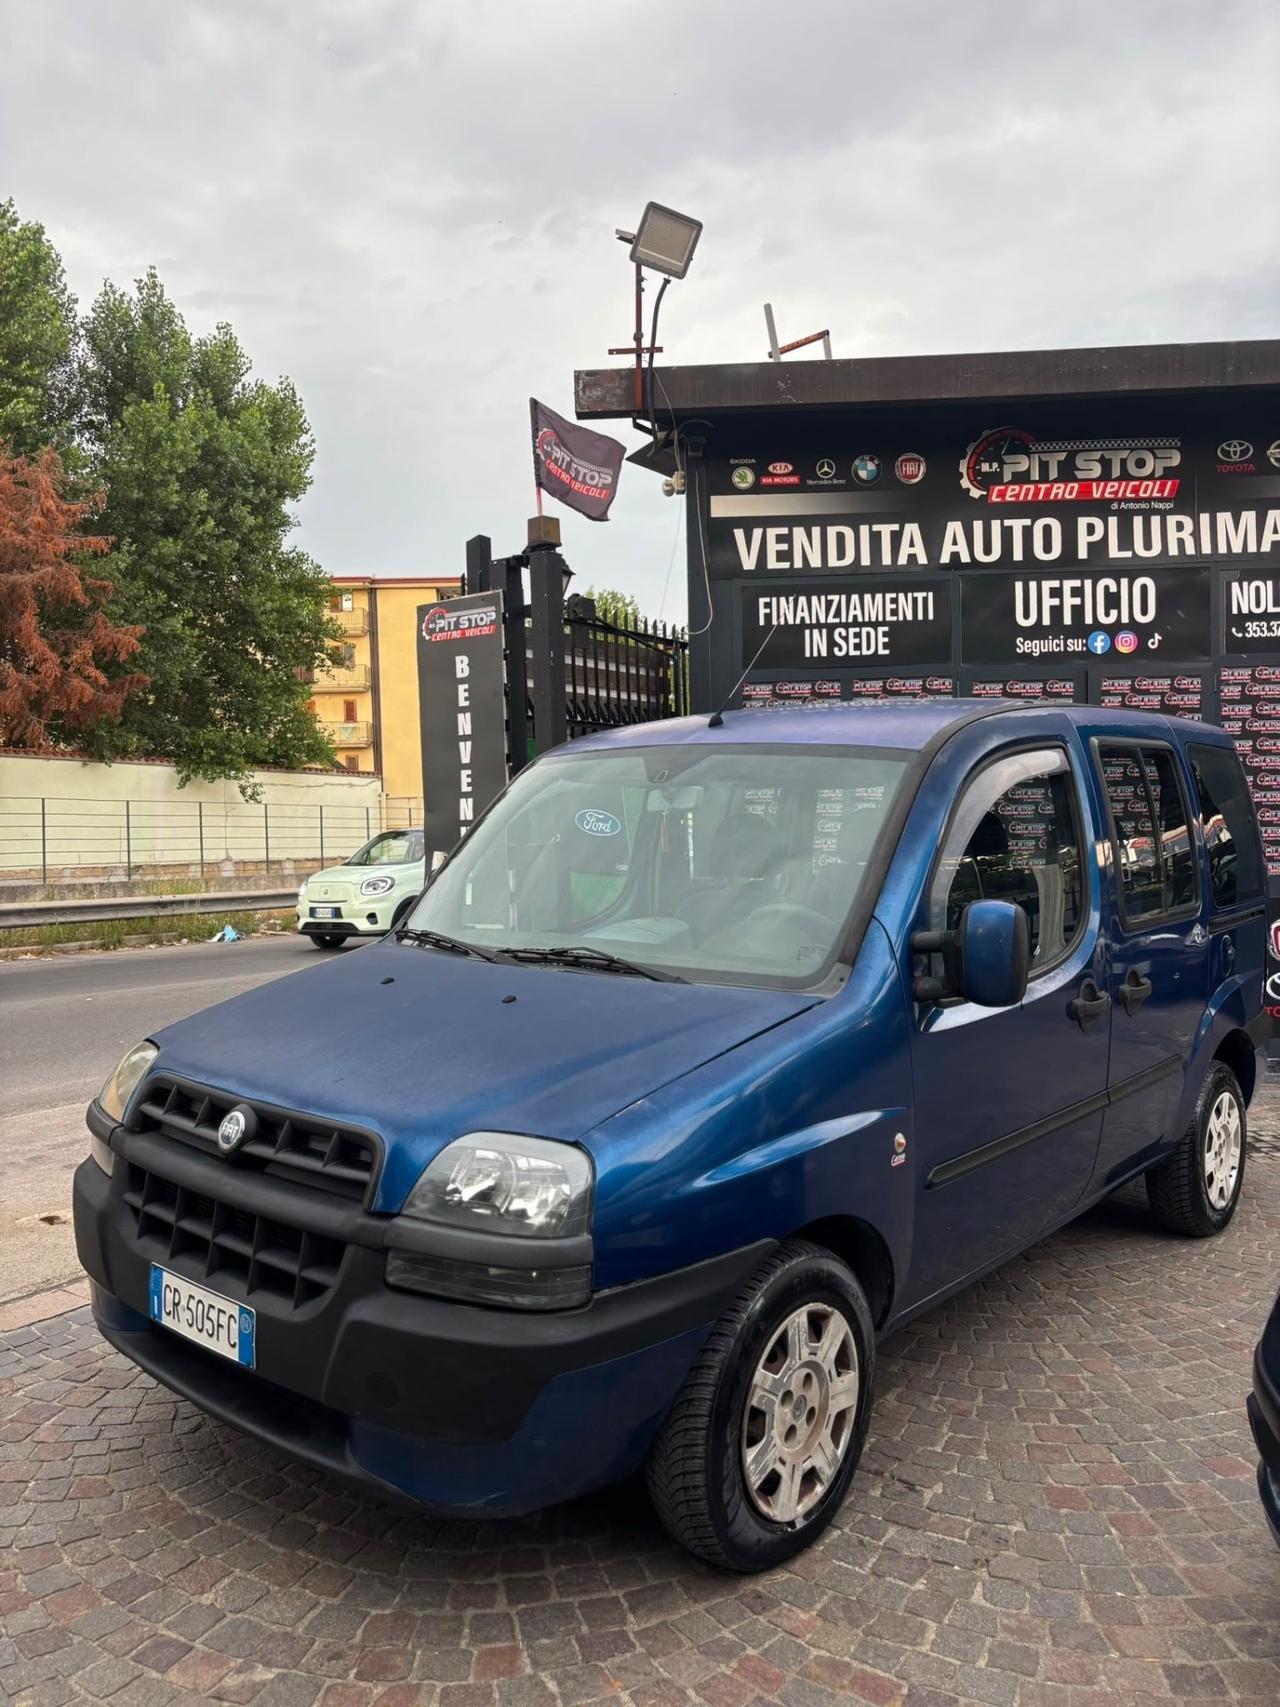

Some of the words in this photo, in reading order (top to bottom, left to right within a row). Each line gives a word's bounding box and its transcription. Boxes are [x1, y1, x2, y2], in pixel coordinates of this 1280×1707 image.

[552, 445, 571, 469] PIT
[570, 464, 612, 487] STOP
[902, 462, 919, 475] FIAT
[981, 462, 1000, 472] M.P.
[1002, 452, 1067, 483] PIT
[1073, 449, 1181, 480] STOP
[1216, 463, 1255, 473] TOYOTA
[1111, 502, 1118, 510] di
[1120, 502, 1149, 510] Antonio
[1151, 501, 1174, 510] Nappi
[733, 523, 928, 571] VENDITA
[939, 517, 1062, 564] AUTO
[1077, 509, 1280, 560] PLURIMA
[758, 591, 934, 626] FINANZIAMENTI
[1014, 576, 1156, 627] UFFICIO
[1231, 580, 1280, 614] NOL
[436, 617, 457, 632] PIT
[459, 611, 496, 629] STOP
[804, 628, 828, 658] IN
[833, 626, 890, 657] SEDE
[1016, 635, 1064, 656] Seguici
[1066, 638, 1086, 652] su:
[583, 811, 612, 832] Ford
[221, 1121, 240, 1138] FIAT
[163, 1284, 181, 1323] CR
[186, 1293, 237, 1348] 505FC
